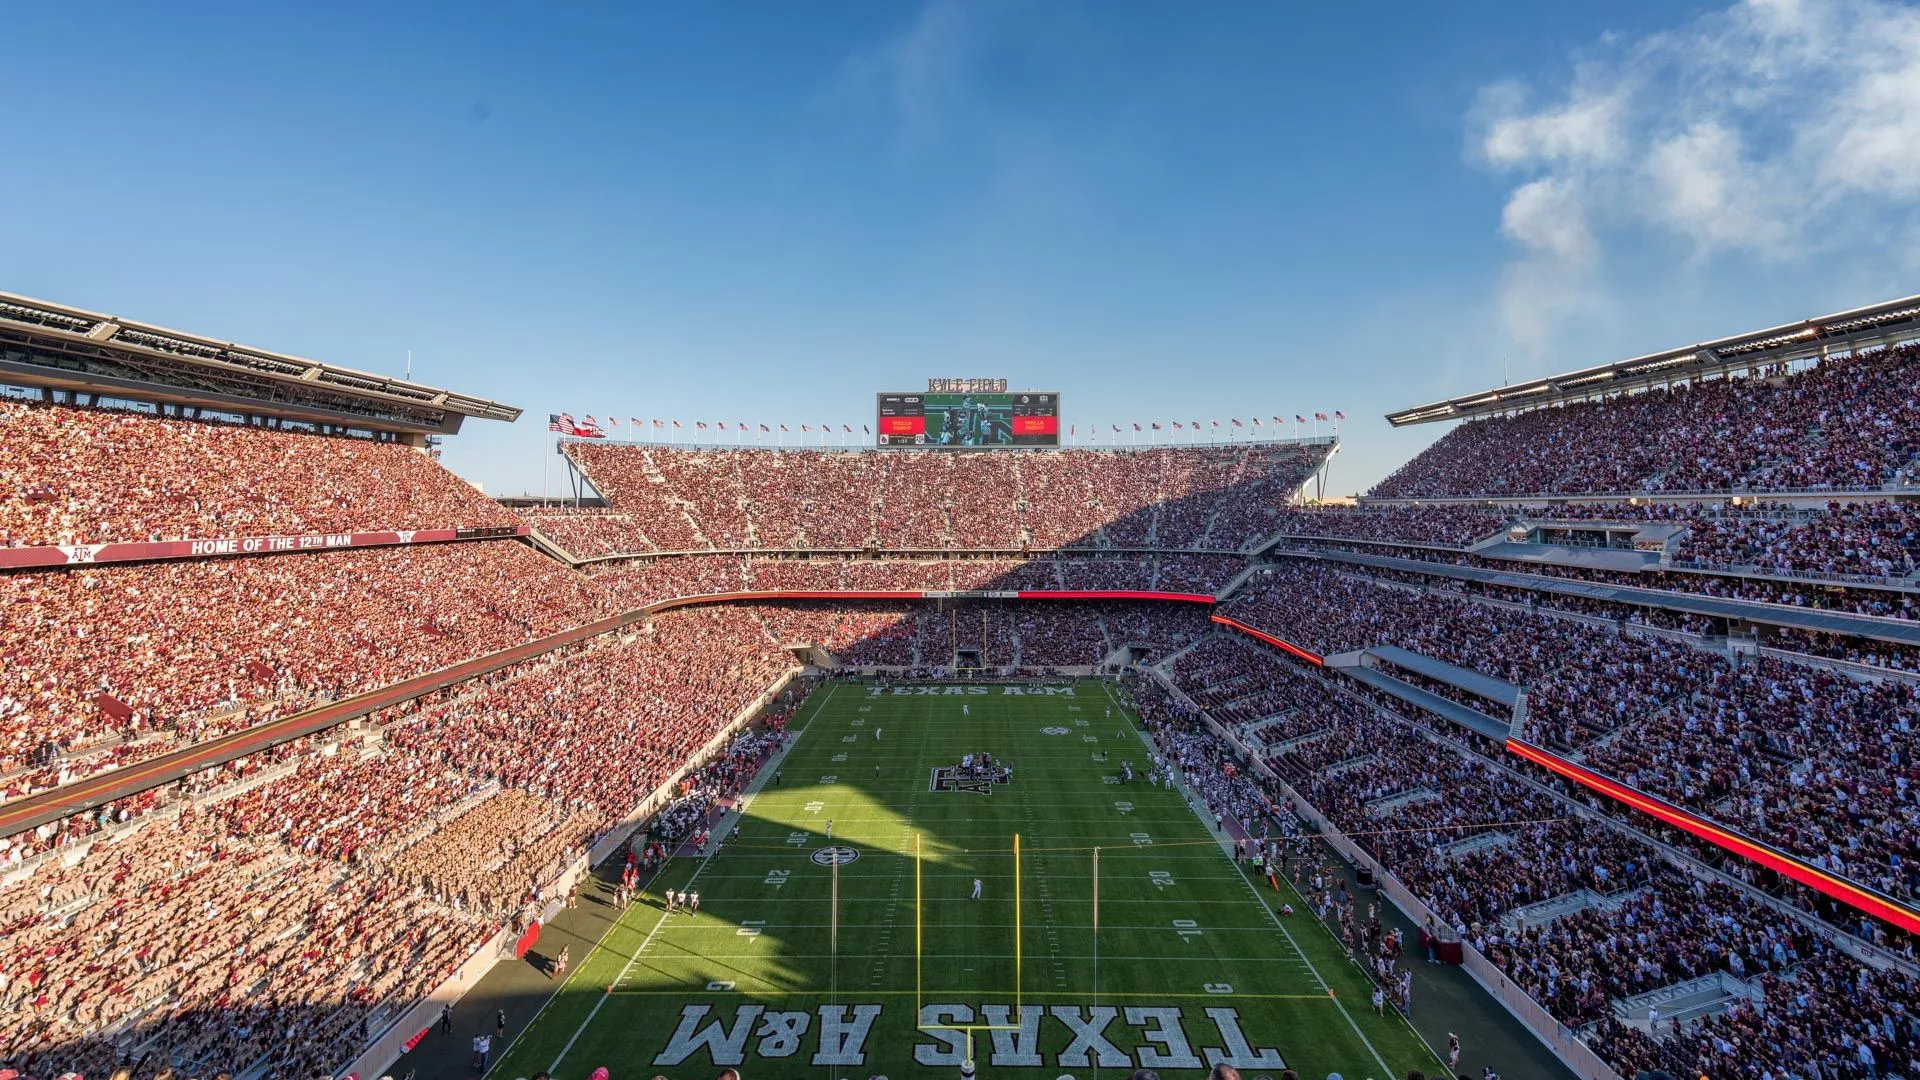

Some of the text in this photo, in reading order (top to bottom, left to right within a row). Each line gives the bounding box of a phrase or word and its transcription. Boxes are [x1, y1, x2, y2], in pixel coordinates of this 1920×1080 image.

[928, 379, 1007, 392] KYLE FIELD
[191, 534, 351, 554] HOME OF THE 12TH MAN
[866, 687, 1076, 696] TEXAS A&M
[804, 801, 825, 811] 40
[786, 832, 809, 843] 30
[1130, 832, 1153, 844] 30
[764, 869, 791, 884] 20
[1148, 871, 1176, 885] 20
[736, 920, 766, 936] 10
[1172, 919, 1203, 935] 10
[652, 1003, 1288, 1069] TEXAS A&M
